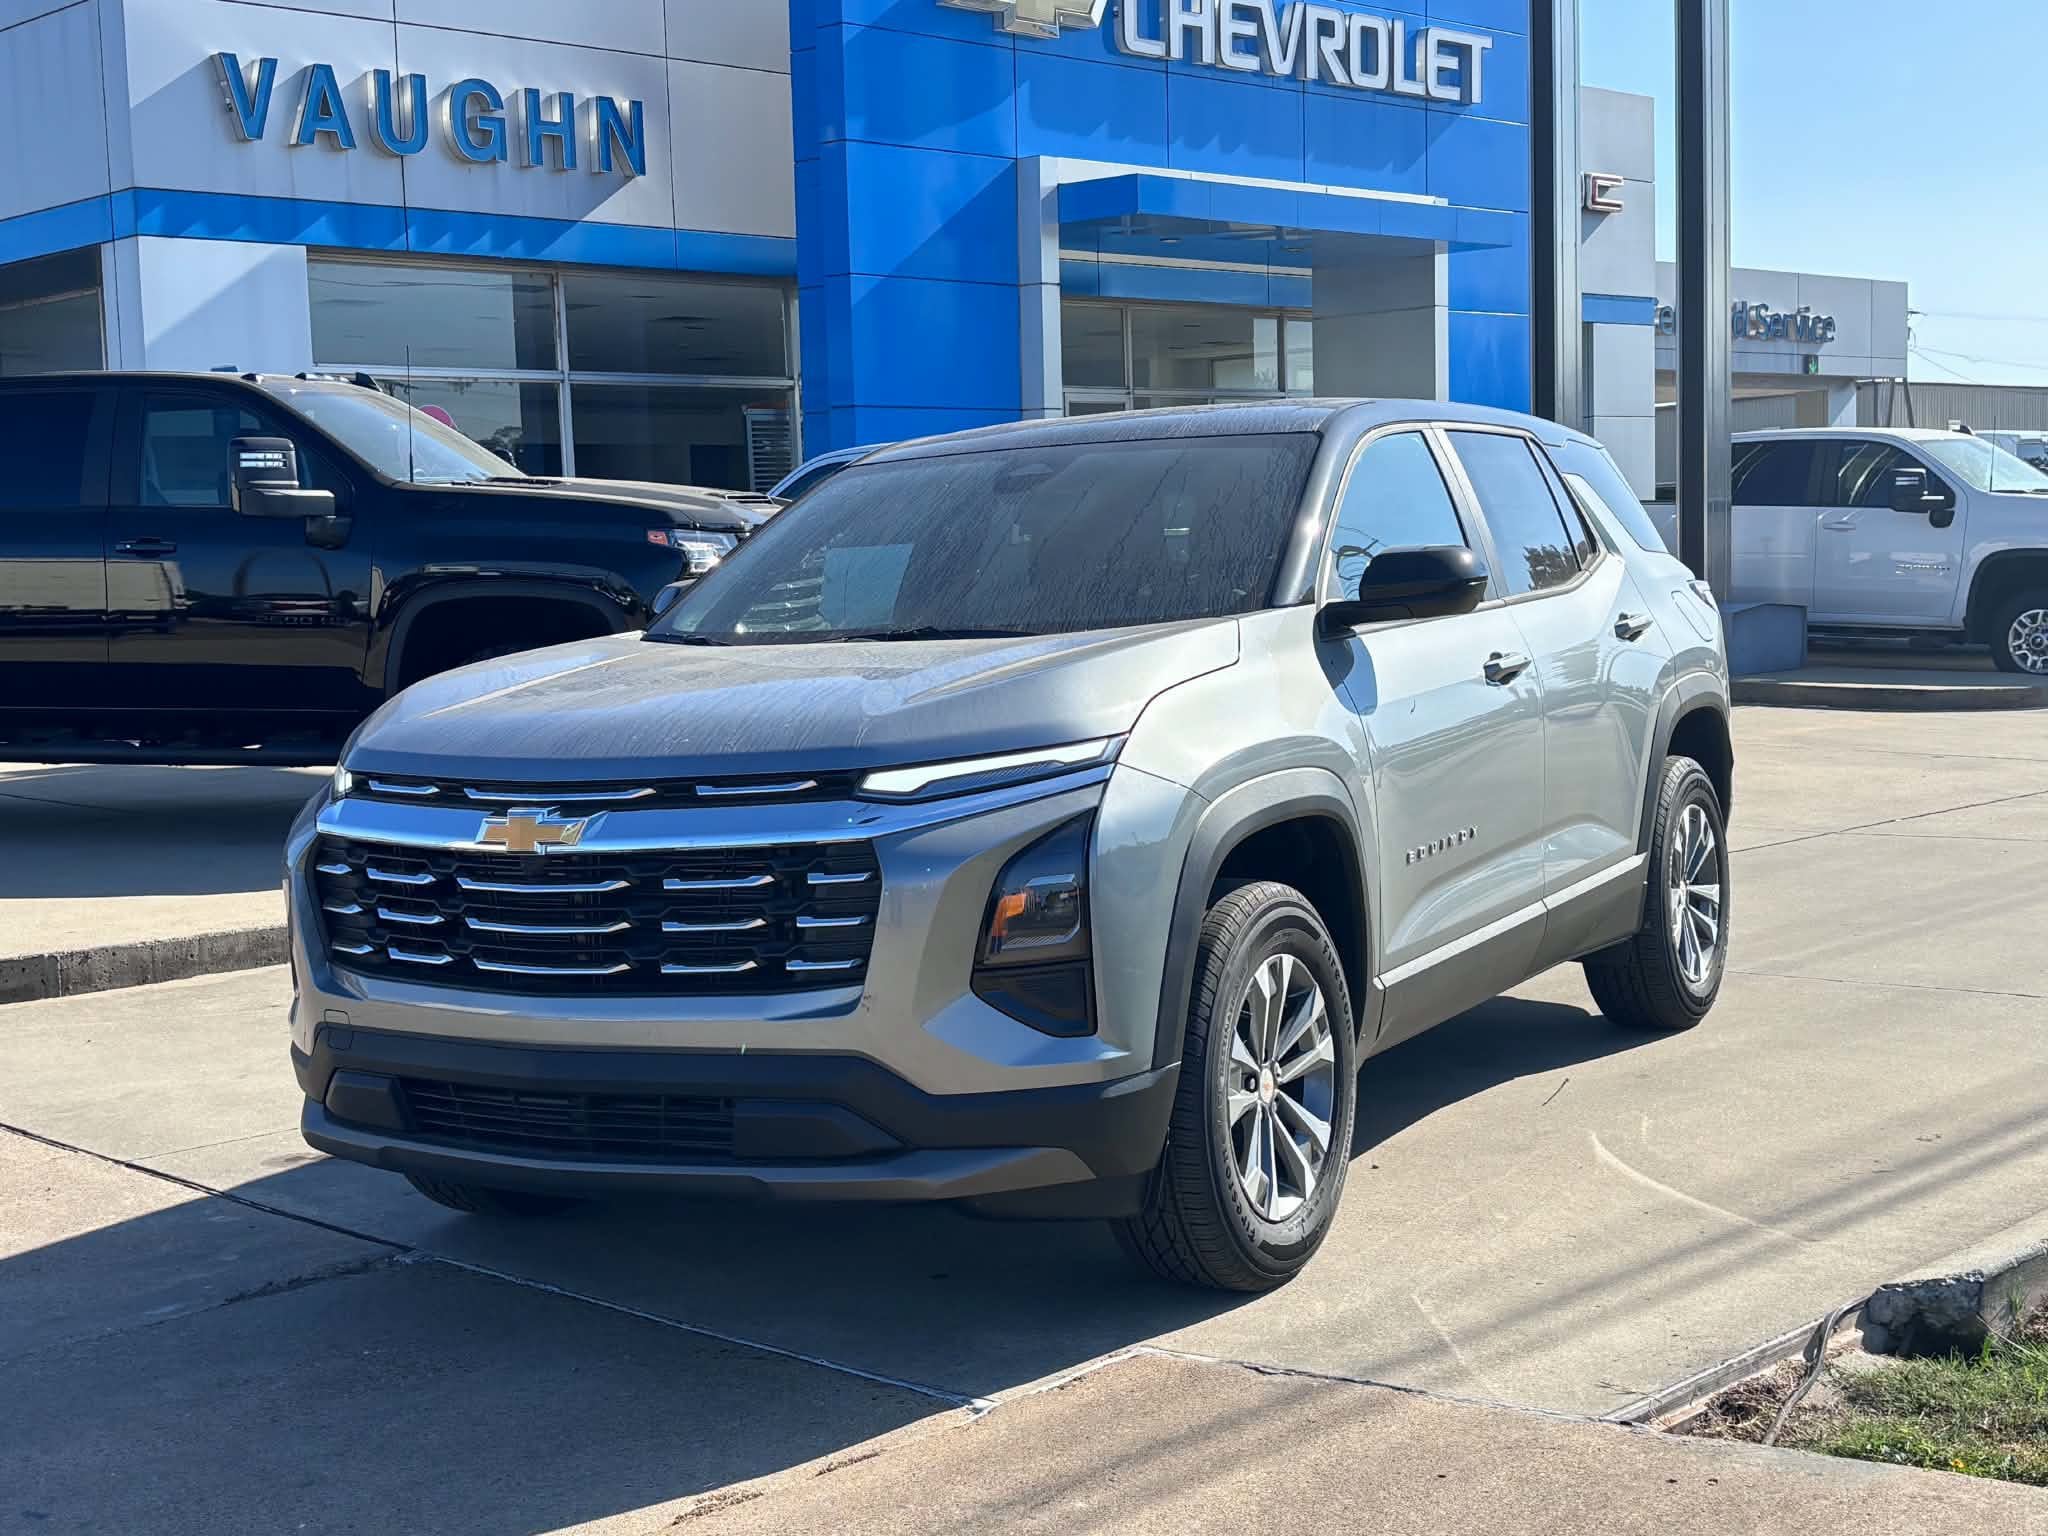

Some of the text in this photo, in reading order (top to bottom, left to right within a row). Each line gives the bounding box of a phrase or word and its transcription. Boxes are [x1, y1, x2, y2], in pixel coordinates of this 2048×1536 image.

[1114, 0, 1493, 104] CHEVROLET
[214, 52, 646, 177] VAUGHN
[1751, 303, 1836, 344] Service
